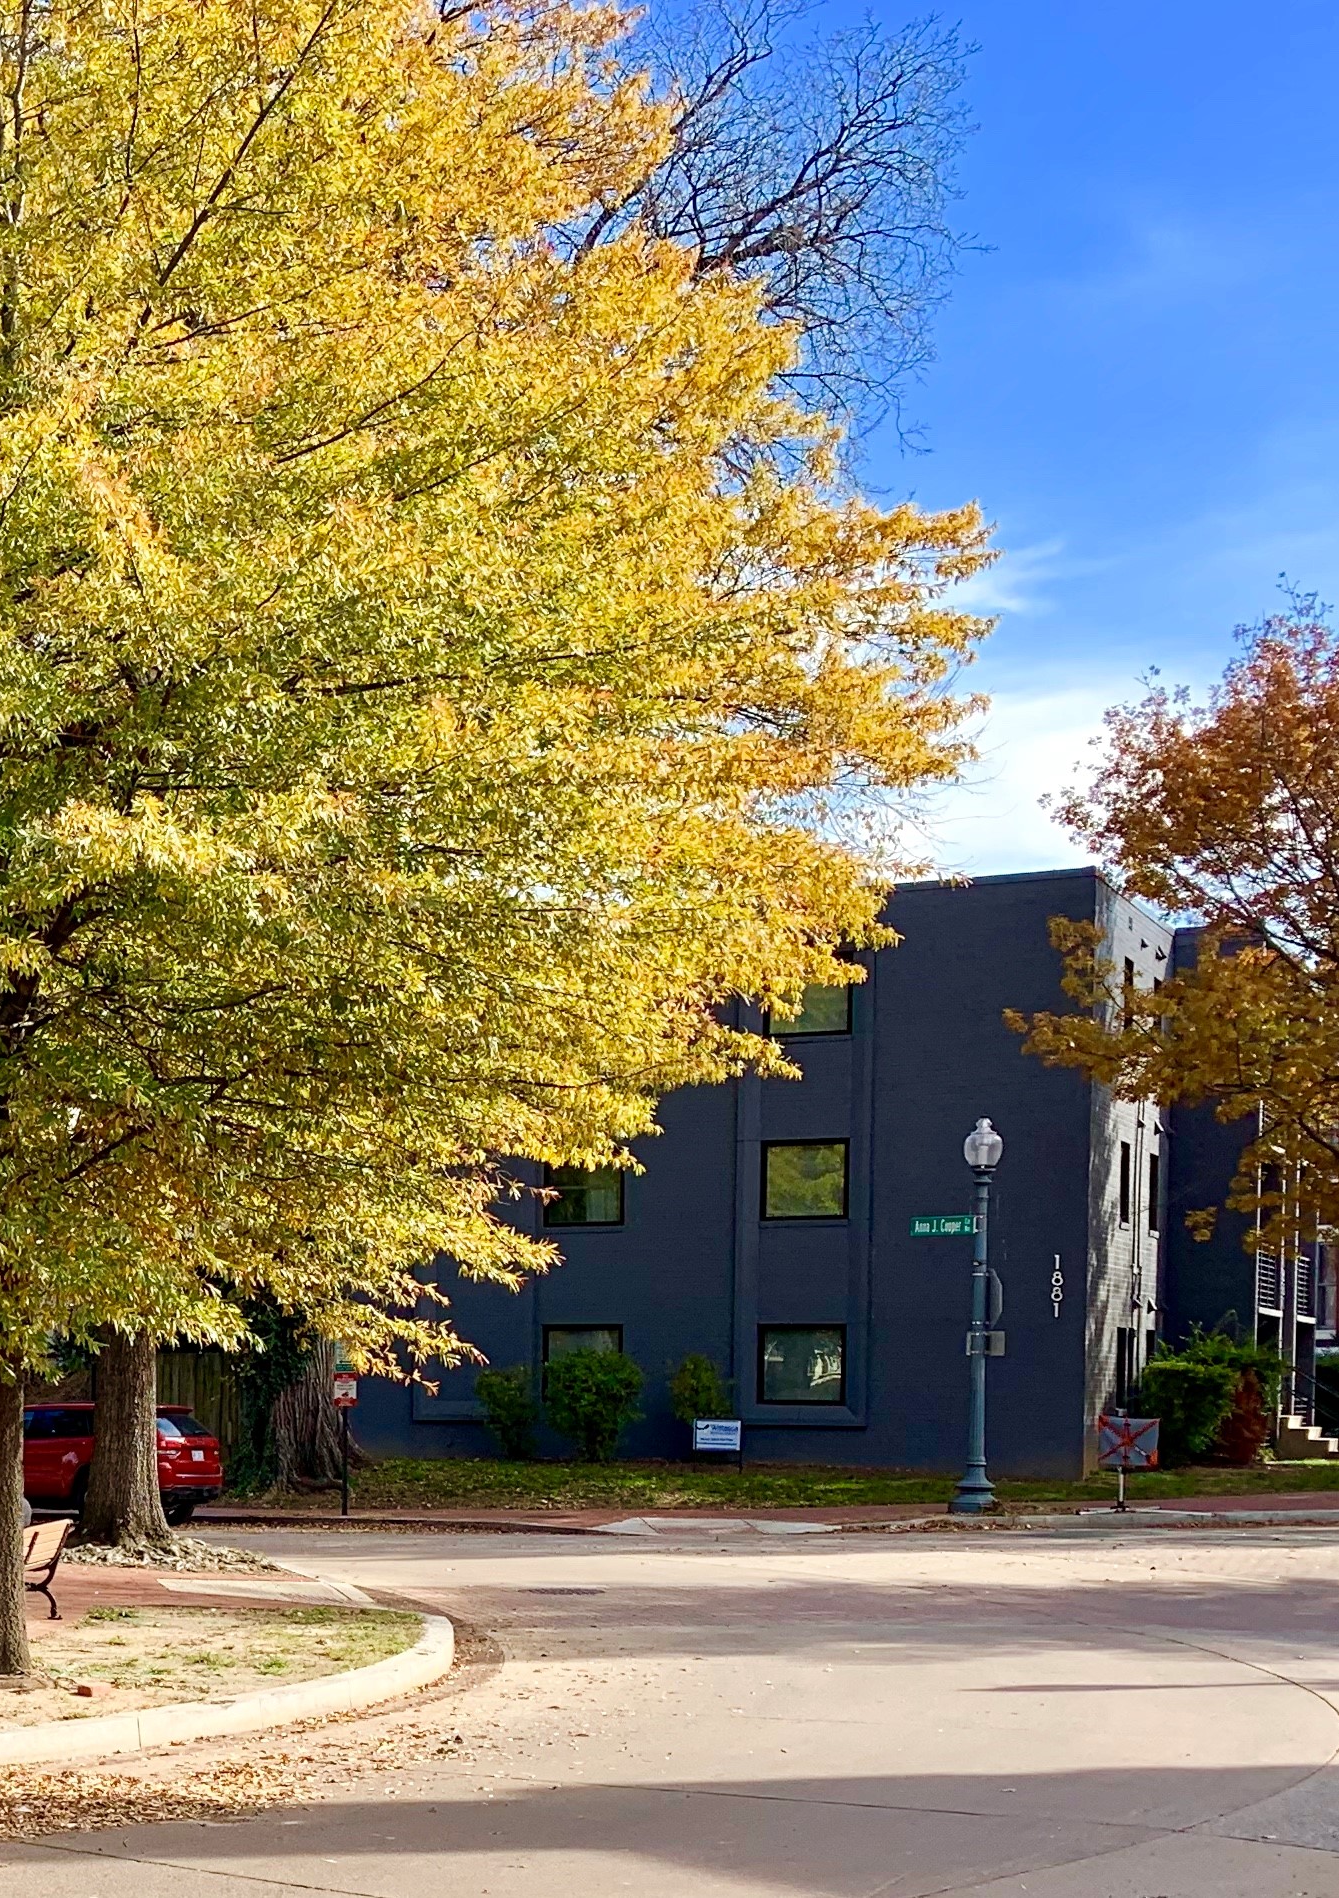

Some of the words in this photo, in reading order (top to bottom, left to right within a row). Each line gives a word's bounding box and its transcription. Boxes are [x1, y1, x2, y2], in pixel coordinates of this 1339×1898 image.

[915, 1221, 930, 1232] Anna
[940, 1219, 961, 1234] Cooper
[1051, 1254, 1063, 1318] 1881
